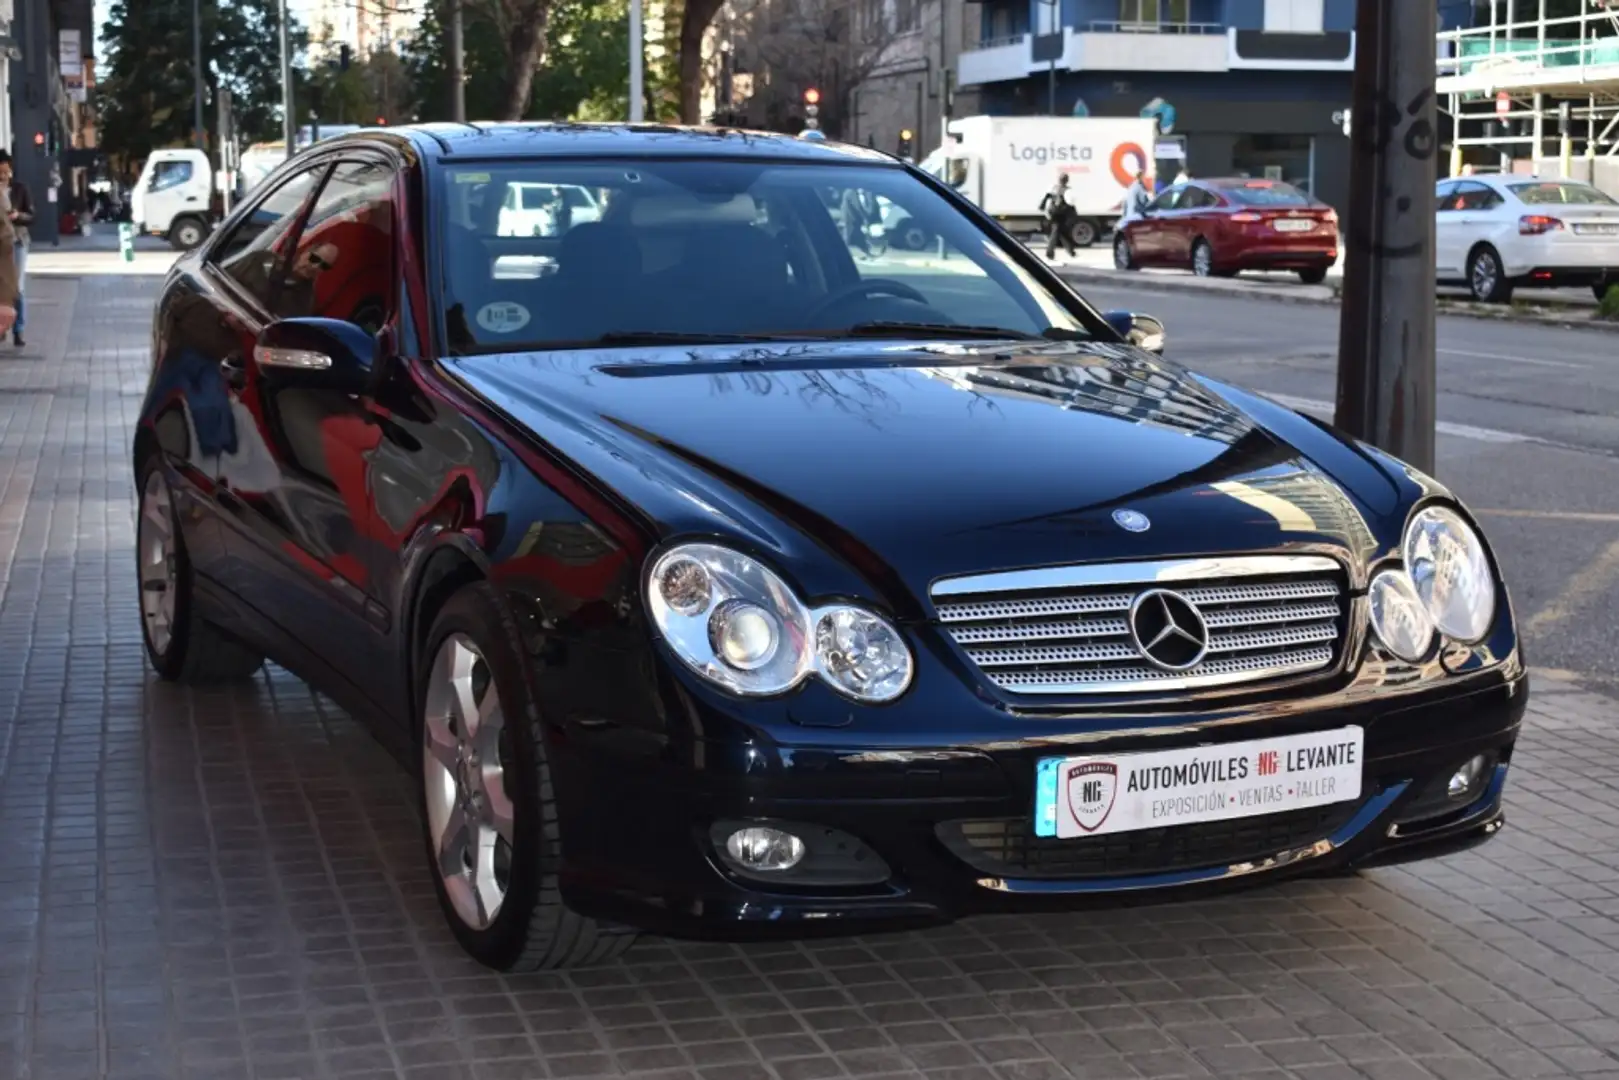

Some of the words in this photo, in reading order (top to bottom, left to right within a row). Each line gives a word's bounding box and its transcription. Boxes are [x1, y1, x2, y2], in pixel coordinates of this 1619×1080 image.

[1127, 758, 1248, 793] AUTOMÓVILES
[1287, 742, 1356, 772] LEVANTE
[1152, 789, 1226, 818] EXPOSICIÓN
[1239, 786, 1283, 806] VENTAS
[1295, 777, 1335, 797] TALLER
